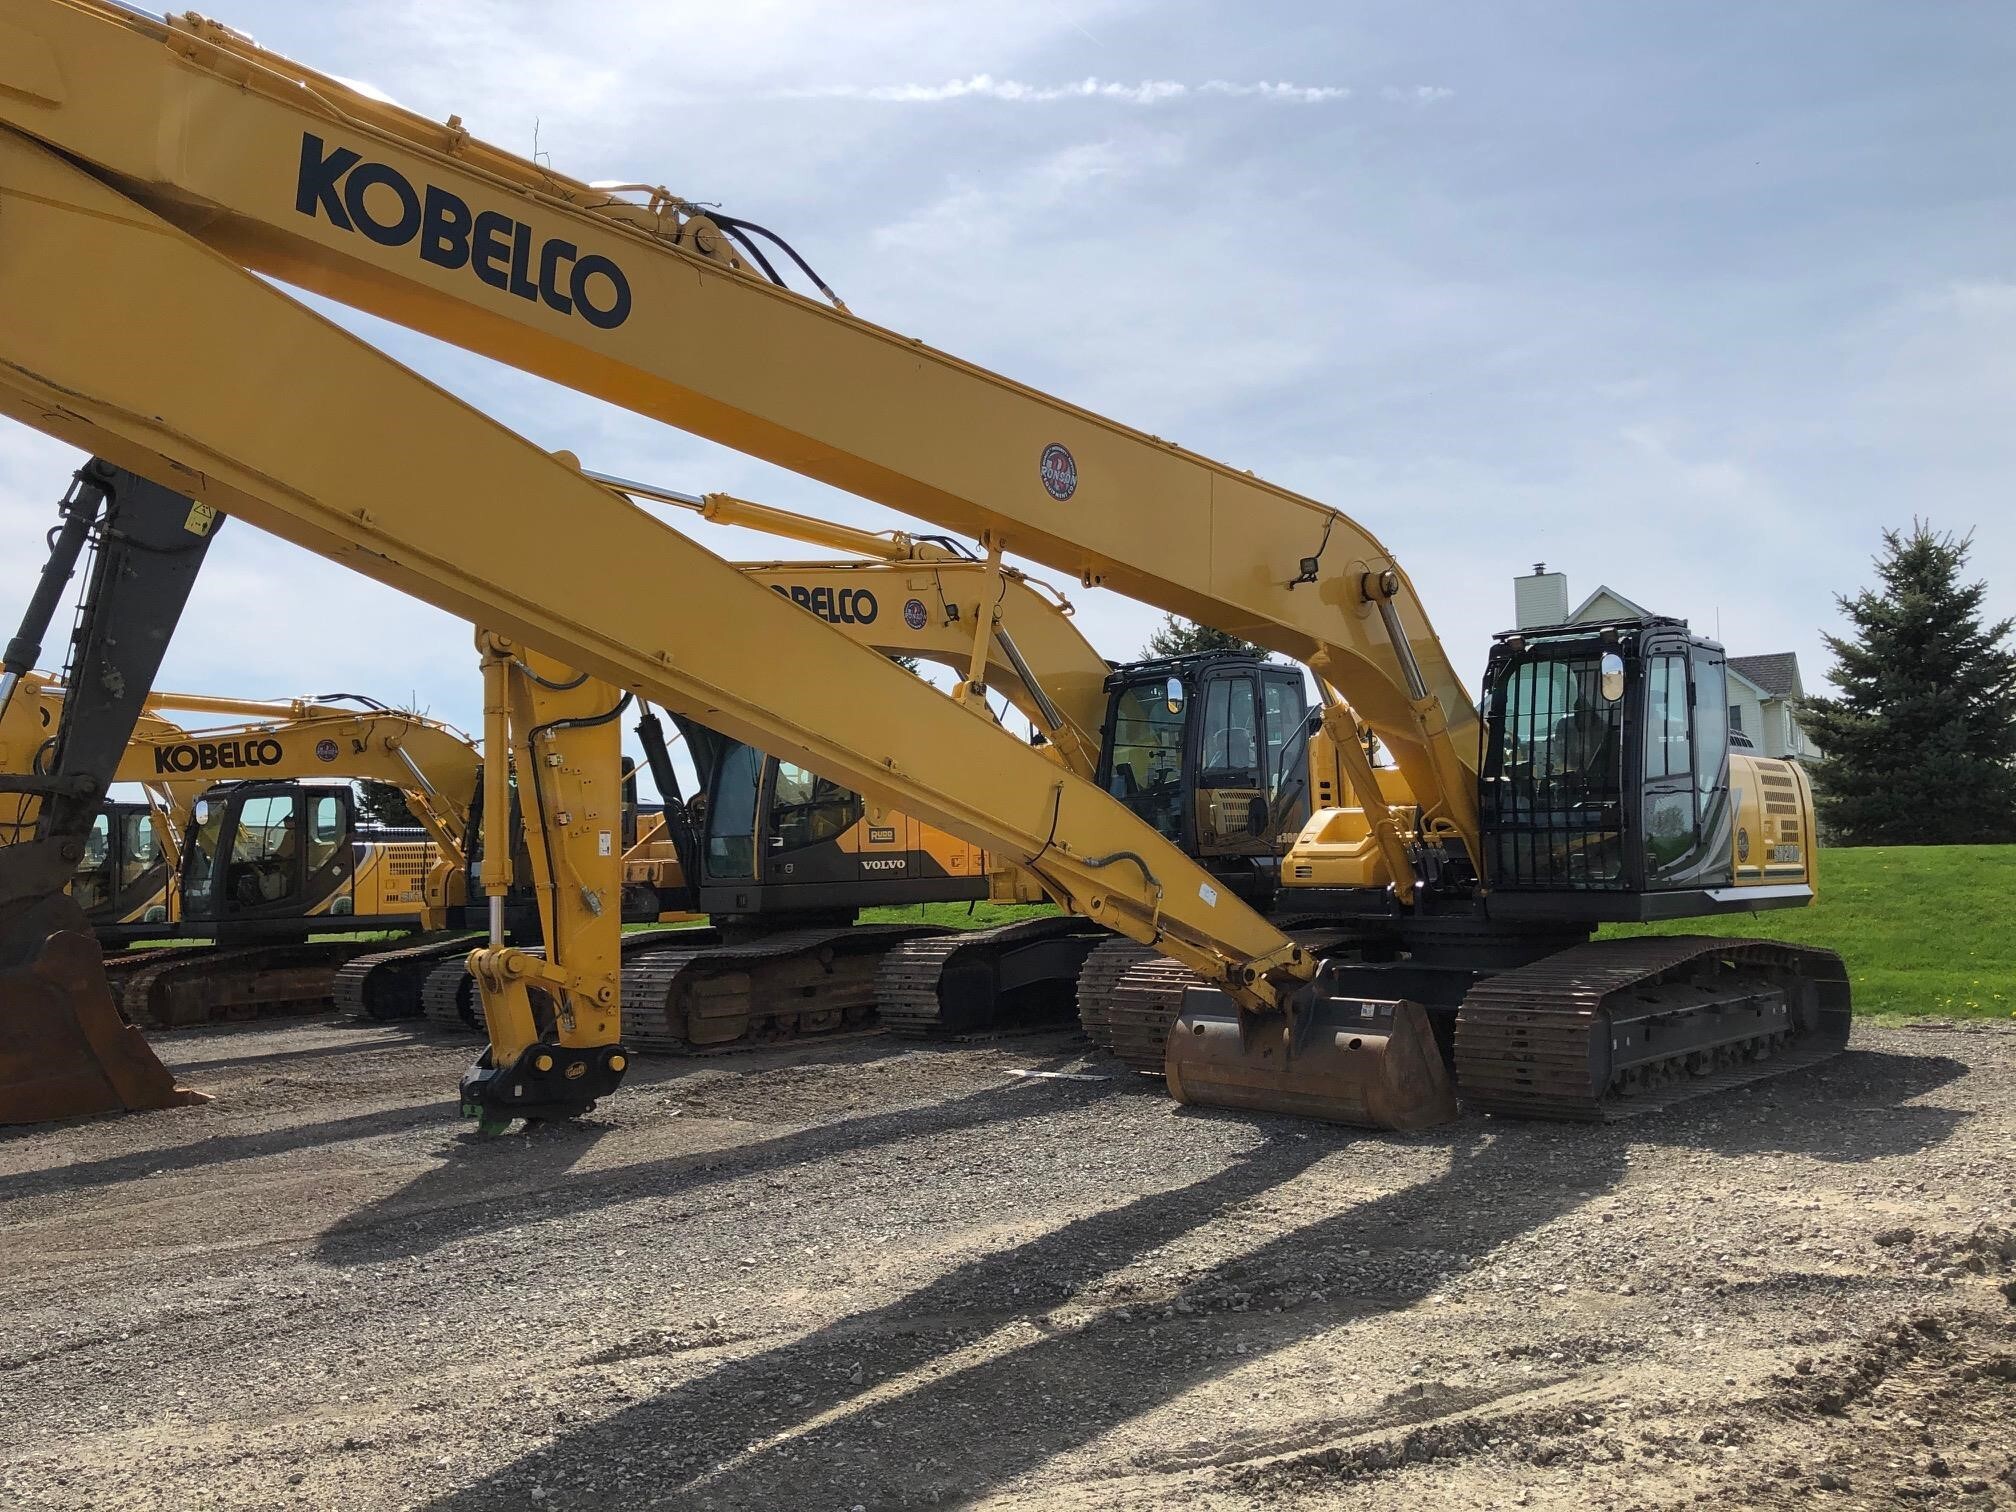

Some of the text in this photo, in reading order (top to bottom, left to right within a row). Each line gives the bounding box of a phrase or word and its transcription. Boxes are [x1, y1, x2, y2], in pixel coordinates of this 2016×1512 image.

[295, 130, 632, 330] KOBELCO
[154, 738, 283, 774] KOBELCO
[862, 860, 905, 870] VOLVO
